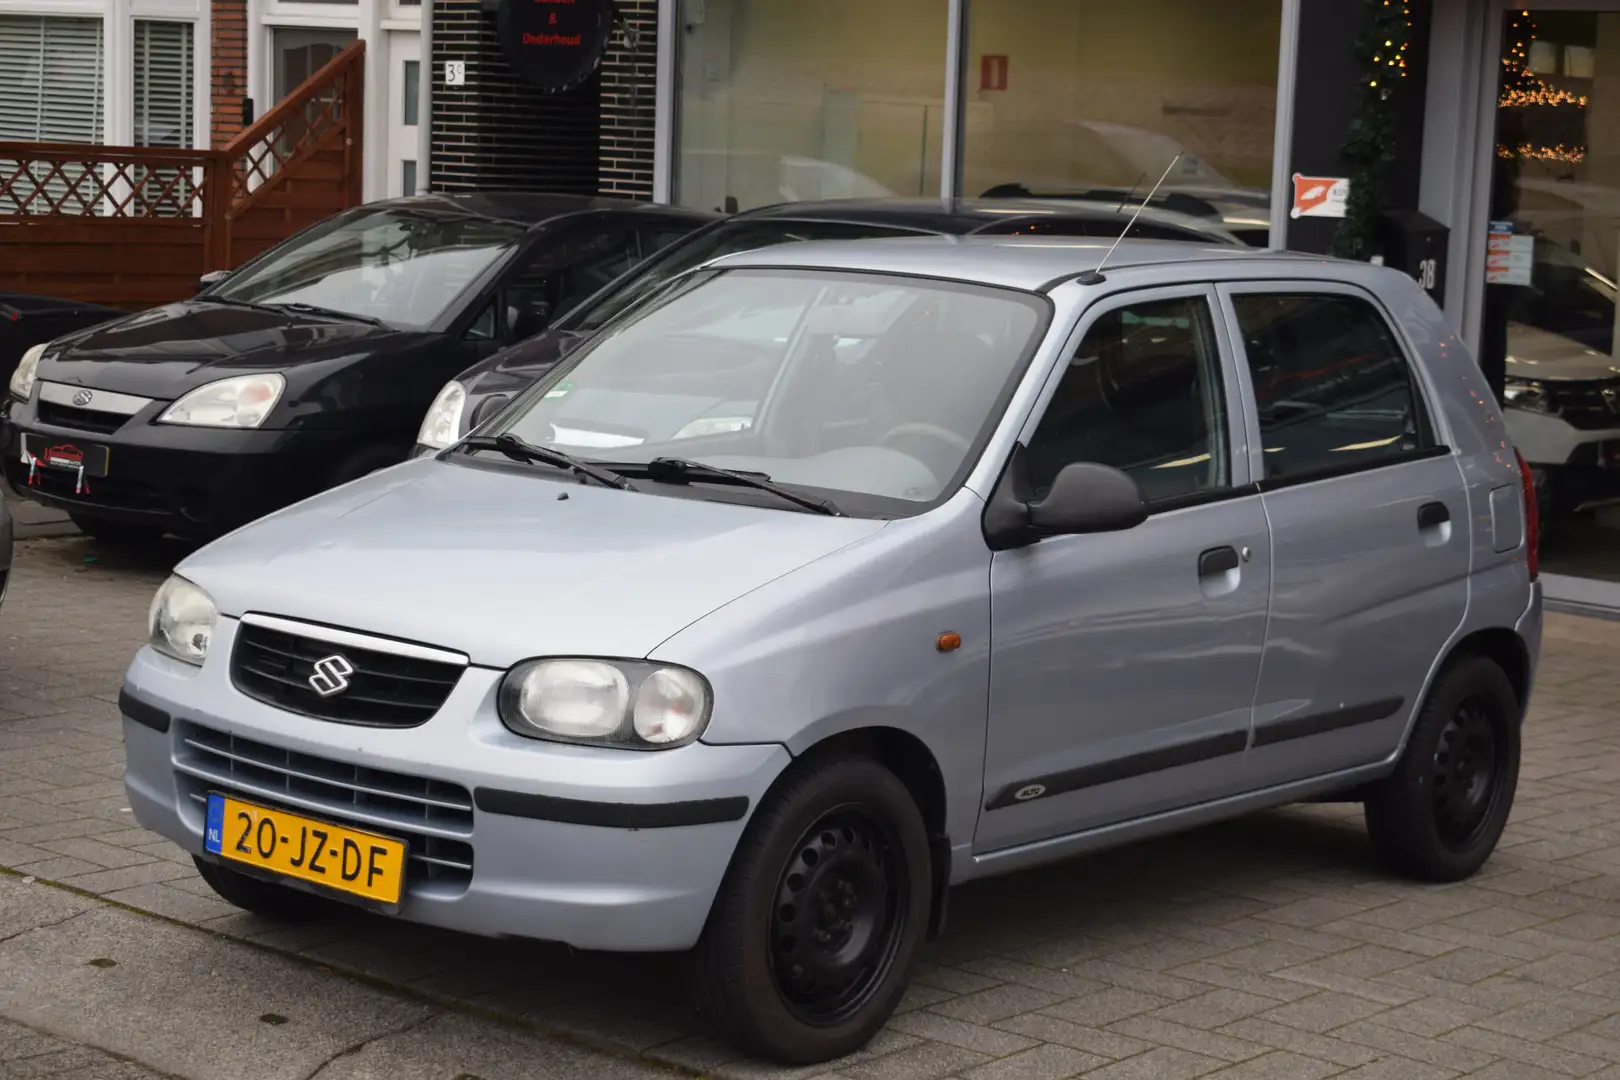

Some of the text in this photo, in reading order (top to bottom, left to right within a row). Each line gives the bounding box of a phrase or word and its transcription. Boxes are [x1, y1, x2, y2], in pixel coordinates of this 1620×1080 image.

[548, 12, 558, 25] &
[522, 32, 581, 46] Onderhoud
[207, 827, 221, 843] NL
[235, 811, 388, 887] 20-JZ-DF
